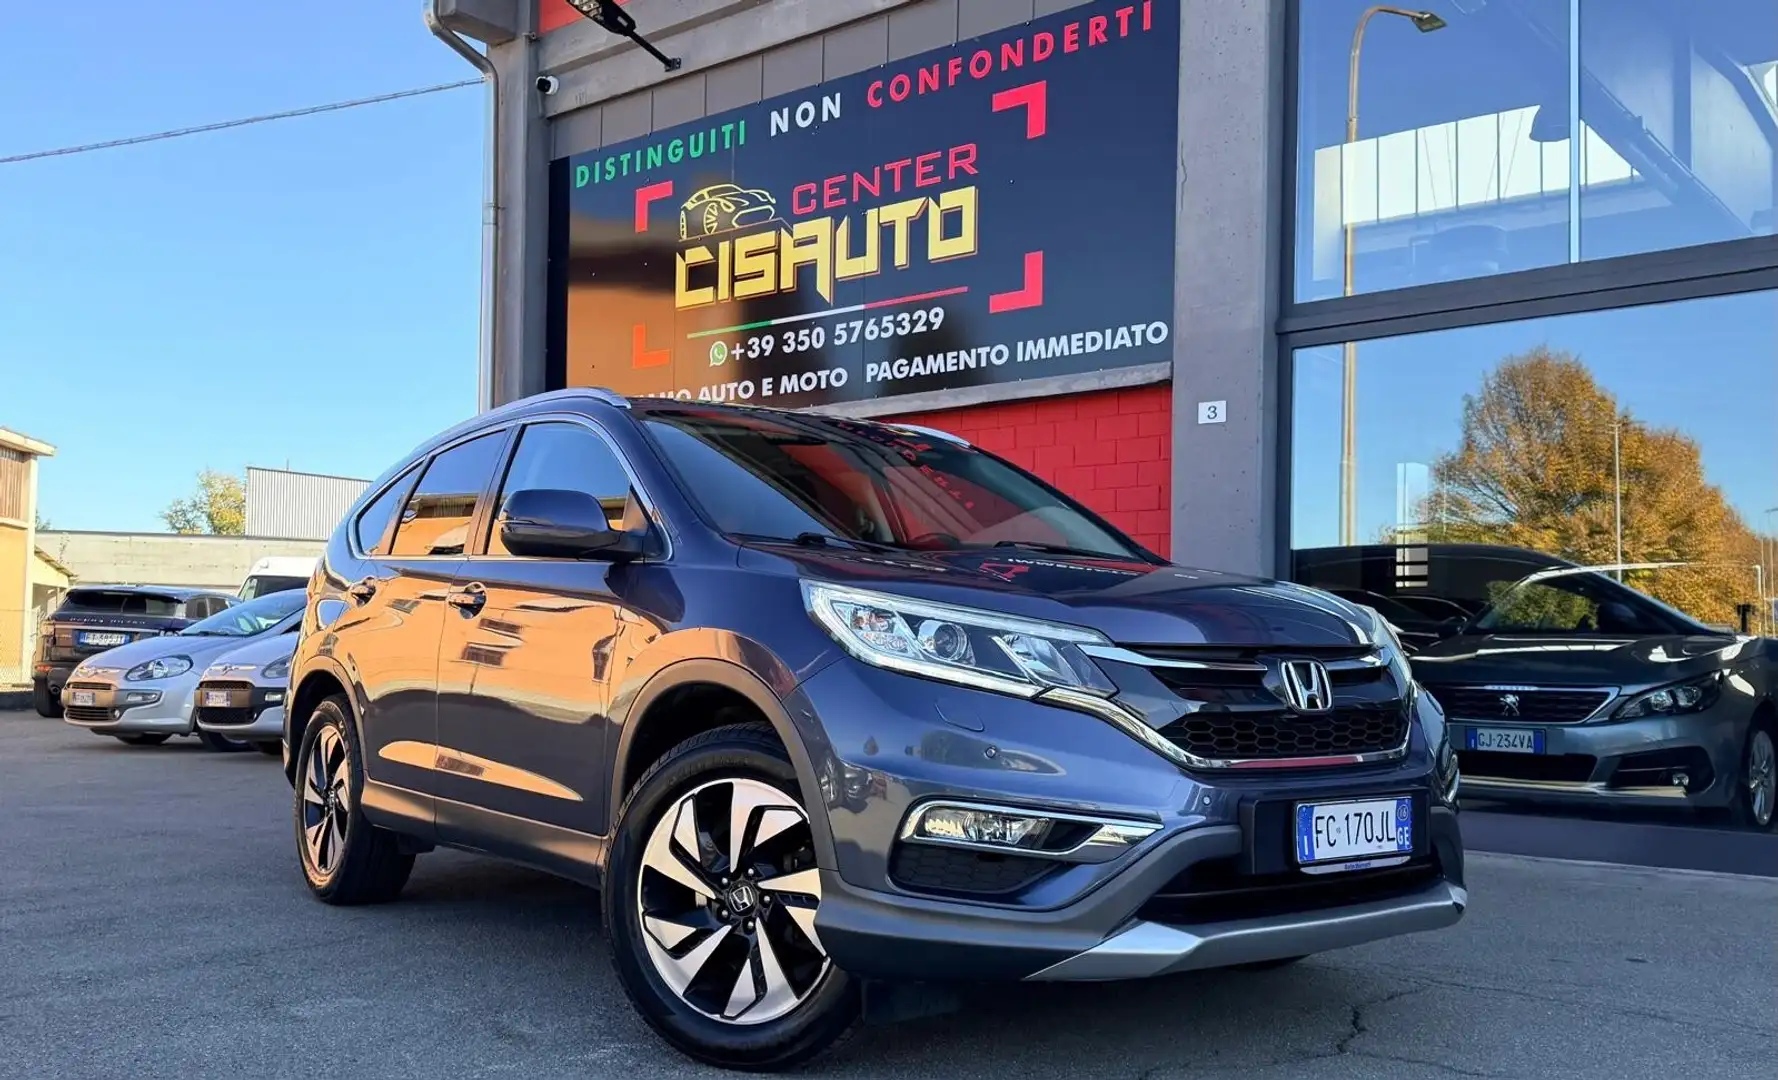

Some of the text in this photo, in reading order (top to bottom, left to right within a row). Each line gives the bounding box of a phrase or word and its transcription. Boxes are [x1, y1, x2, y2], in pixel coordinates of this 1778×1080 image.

[576, 0, 1152, 188] DISTINGUITI NON CONFONDERTI
[792, 143, 979, 215] CENTER
[675, 185, 978, 310] CISAUTO
[698, 381, 755, 402] AUTO
[761, 377, 773, 397] E
[780, 367, 848, 395] MOTO
[866, 344, 1009, 383] PAGAMENTO
[1016, 321, 1169, 363] IMMEDIATO
[731, 307, 945, 361] +39 350 5765329
[1207, 405, 1218, 420] 3
